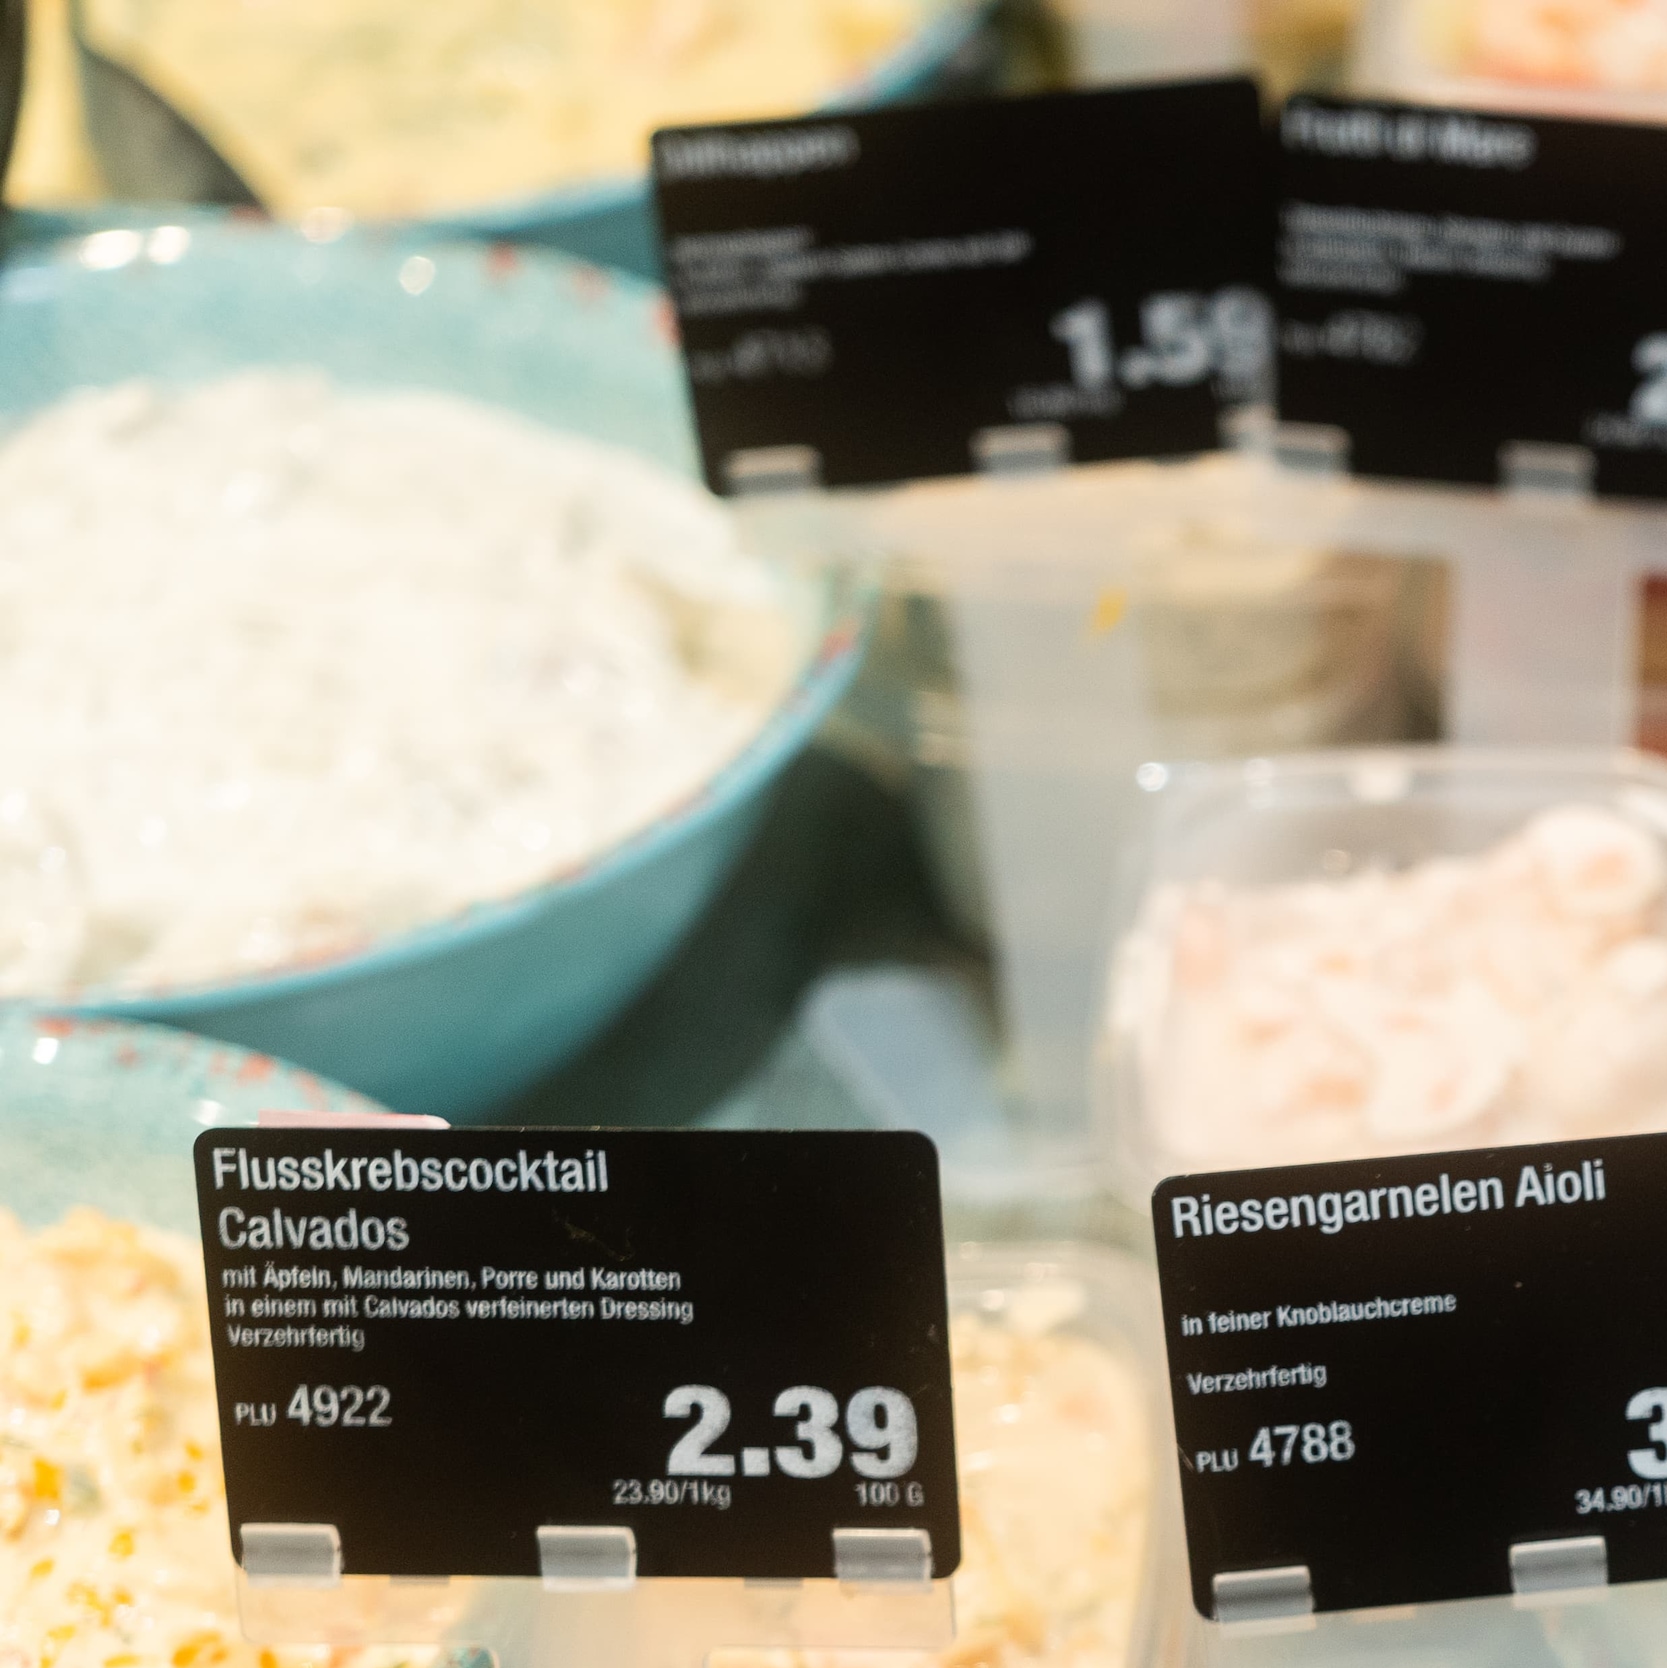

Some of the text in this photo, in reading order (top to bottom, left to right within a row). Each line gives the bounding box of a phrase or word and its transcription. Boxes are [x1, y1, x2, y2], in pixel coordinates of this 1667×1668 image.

[211, 1147, 609, 1192] Flusskrebscocktail
[1171, 1158, 1606, 1238] Riesengarnelen Aioli
[218, 1206, 410, 1251] Calvados
[221, 1261, 682, 1291] mit Äpfeln, Mandarinen, Porre und Karotten
[224, 1293, 694, 1325] in einem mit Calvados verfeinerten Dressing
[1181, 1294, 1457, 1337] in feiner Knoblauchcreme
[226, 1324, 365, 1351] Verzehrfertig
[1186, 1363, 1328, 1395] Verzehrfertig
[234, 1384, 392, 1427] PLU 4922
[664, 1386, 917, 1478] 2.39
[1195, 1420, 1356, 1473] PLU 4788
[613, 1479, 732, 1511] 23.90/1kg
[855, 1481, 925, 1507] 100 G
